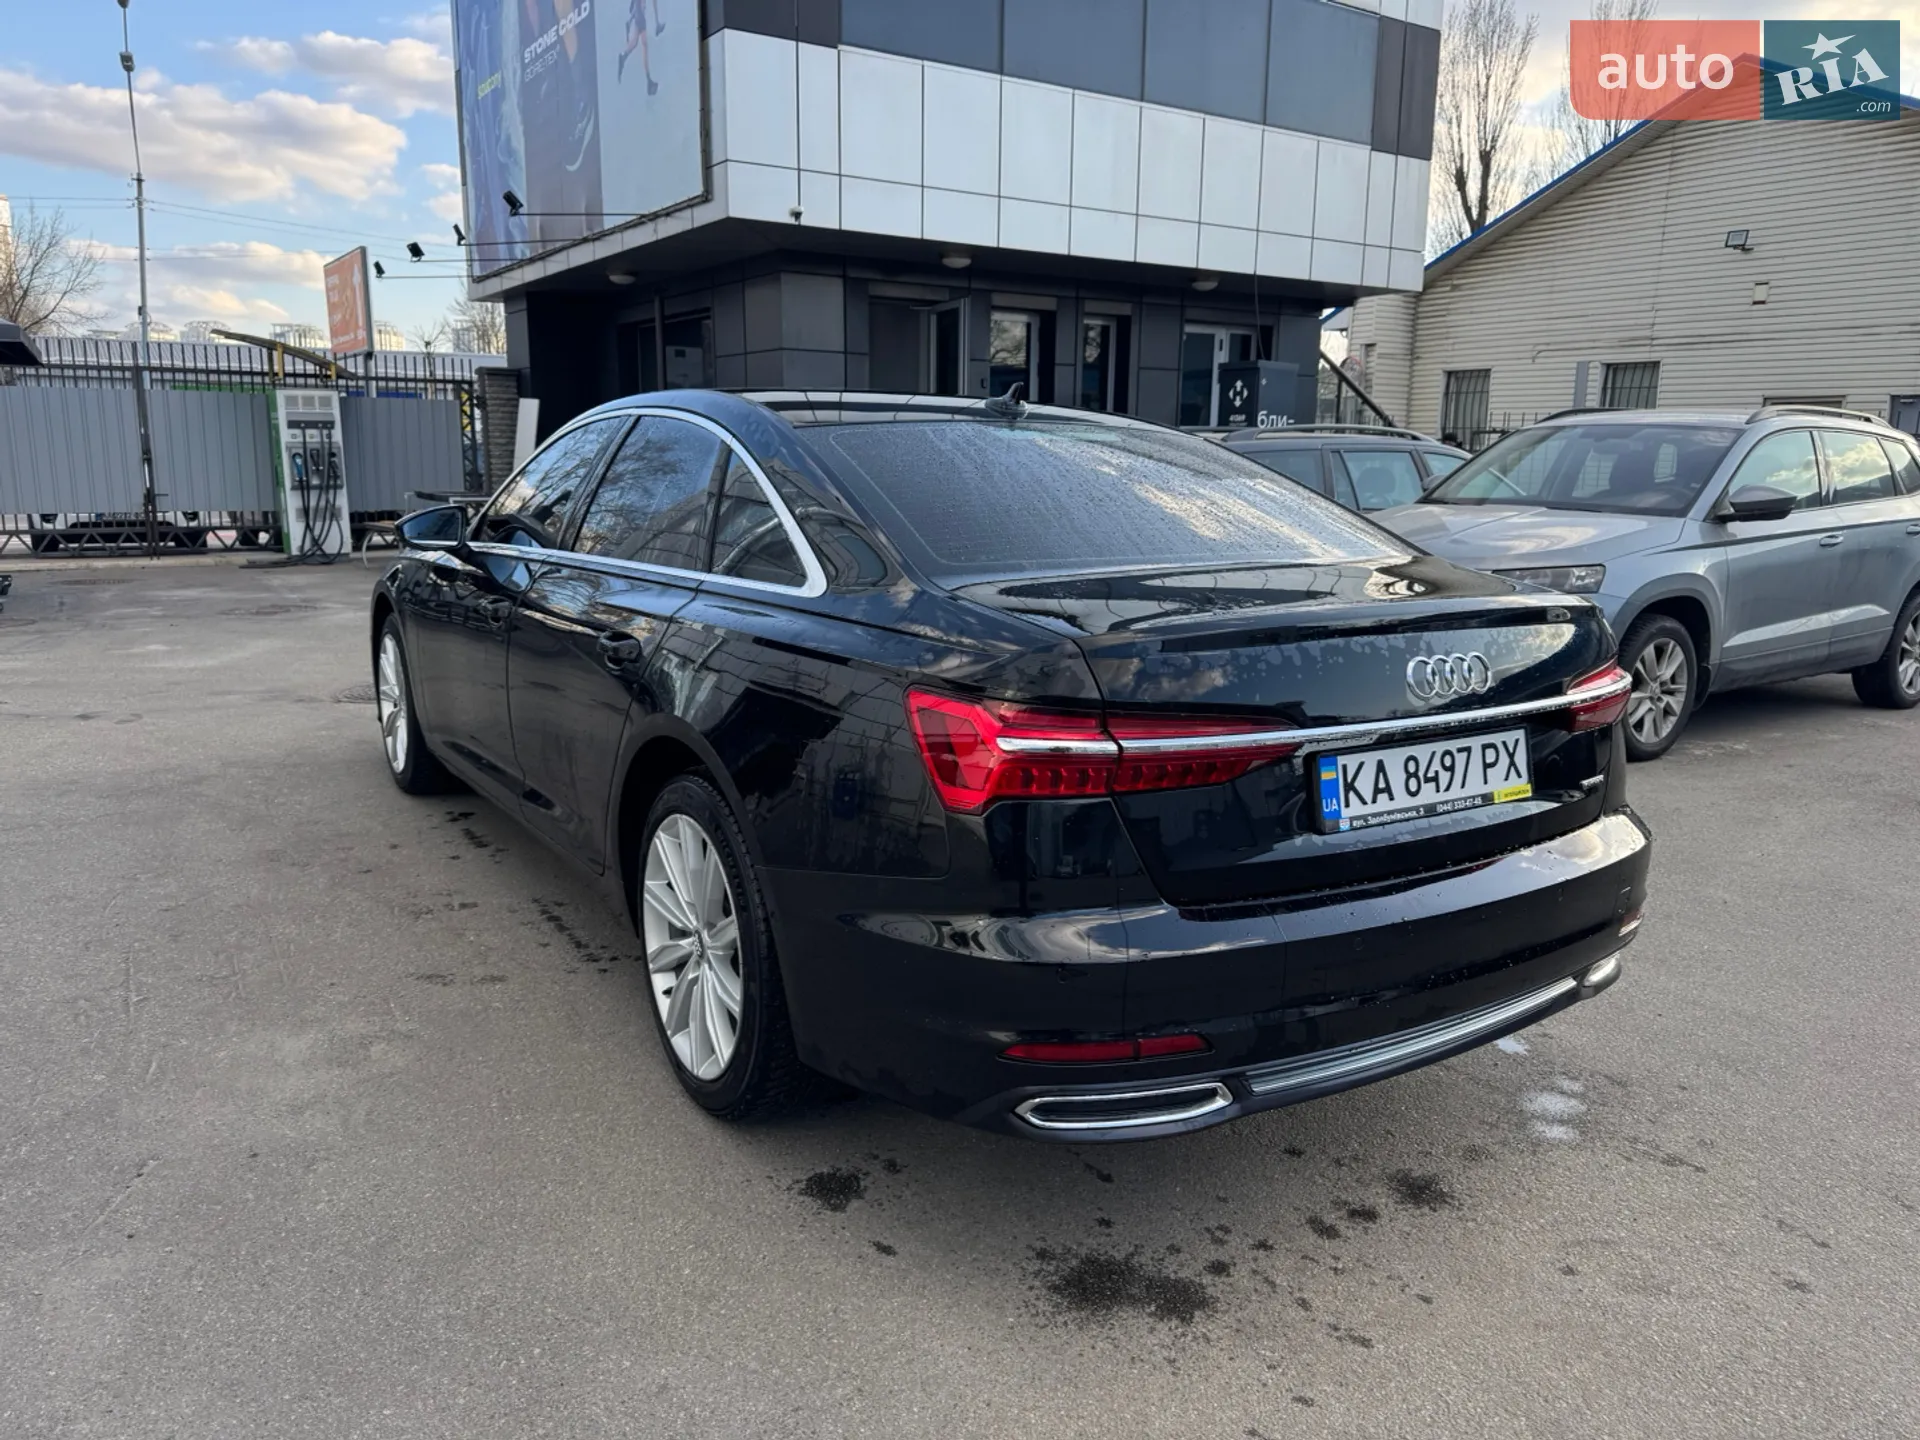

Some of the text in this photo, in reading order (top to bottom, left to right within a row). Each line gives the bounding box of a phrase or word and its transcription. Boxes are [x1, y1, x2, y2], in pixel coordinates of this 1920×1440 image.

[523, 1, 591, 64] STONE COLD
[1257, 410, 1295, 428] бли-
[1341, 737, 1523, 808] KA 8497 PX
[1323, 797, 1339, 812] UA
